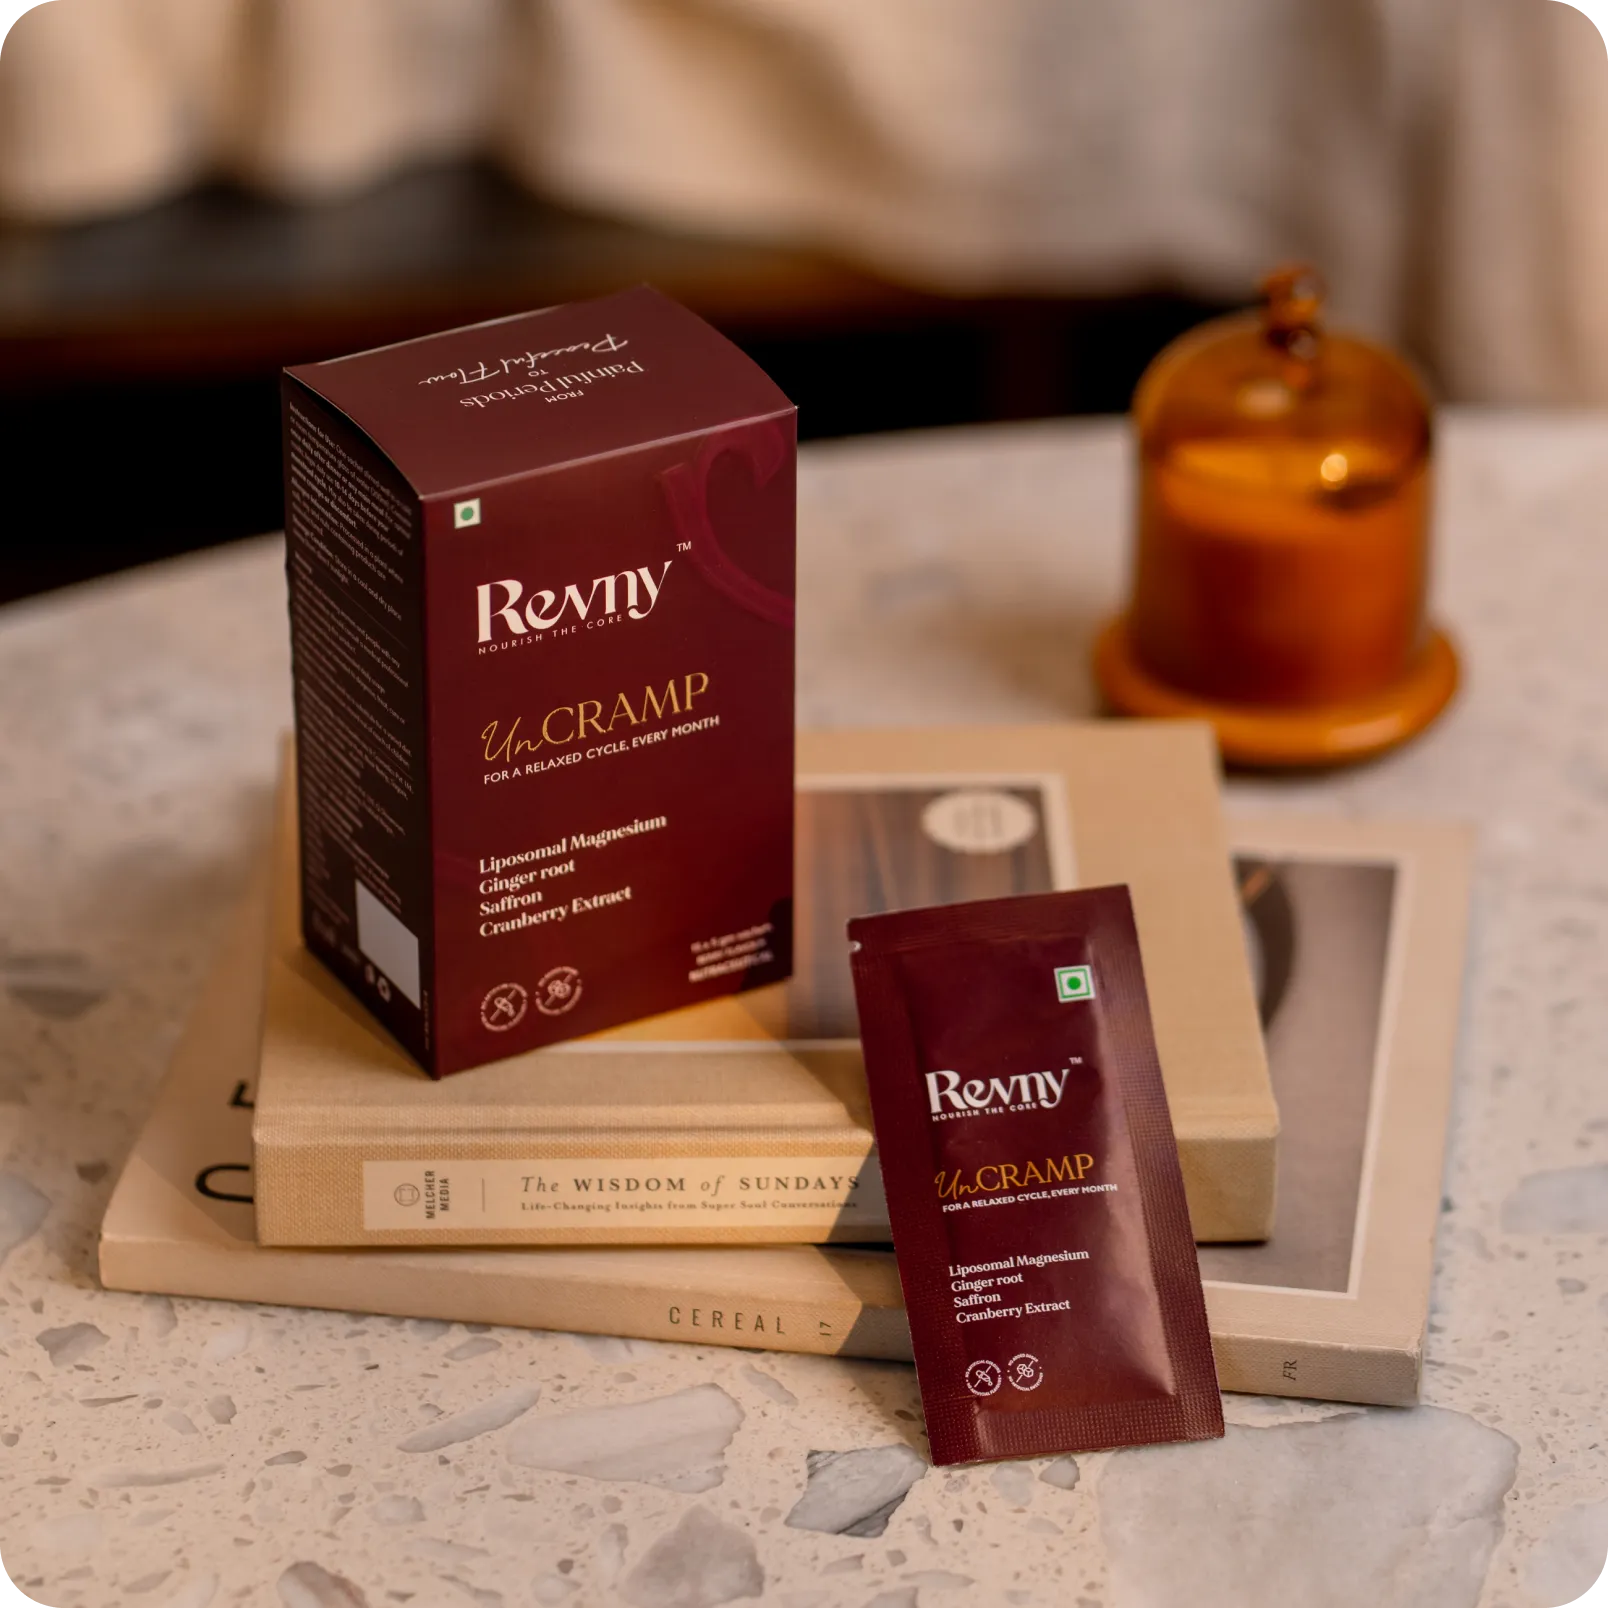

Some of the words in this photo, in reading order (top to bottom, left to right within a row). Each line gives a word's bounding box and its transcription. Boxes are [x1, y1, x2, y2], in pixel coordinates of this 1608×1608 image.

[500, 333, 629, 374] Peaceful
[418, 361, 501, 385] Flow
[528, 369, 549, 377] TO
[556, 361, 645, 389] Painful
[460, 380, 557, 408] Periods
[545, 389, 585, 403] FROM
[478, 633, 543, 655] NOURISH
[552, 625, 577, 638] THE
[587, 614, 623, 629] CORE
[481, 672, 709, 762] UnCRAMP
[484, 770, 509, 785] FOR
[512, 767, 522, 778] A
[525, 752, 583, 775] RELAXED
[586, 740, 630, 759] CYCLE,
[632, 728, 668, 748] EVERY
[672, 715, 720, 738] MONTH
[479, 838, 567, 874] Liposomal
[570, 815, 667, 849] Magnesium
[479, 870, 538, 895] Ginger
[541, 859, 575, 880] root
[479, 890, 543, 916] Saffron
[479, 904, 569, 937] Cranberry
[572, 885, 632, 914] Extract
[932, 1109, 981, 1122] NOURISH
[985, 1106, 1004, 1115] THE
[1009, 1102, 1038, 1112] CORE
[521, 1175, 559, 1193] The
[573, 1177, 686, 1192] WISDOM
[700, 1175, 725, 1197] of
[739, 1176, 861, 1191] SUNDAYS
[934, 1153, 1094, 1200] UnCRAMP
[424, 1170, 436, 1219] MELCHER
[439, 1177, 450, 1212] MEDIA
[521, 1201, 611, 1213] Life-Changing
[615, 1201, 663, 1211] Insights
[667, 1200, 697, 1210] from
[701, 1200, 736, 1212] Super
[740, 1199, 767, 1210] Soul
[772, 1199, 858, 1210] Conversations
[942, 1202, 962, 1213] FOR
[962, 1201, 971, 1210] A
[972, 1195, 1016, 1208] RELAXED
[1017, 1190, 1051, 1202] CYCLE,
[1051, 1187, 1080, 1198] EVERY
[1082, 1183, 1118, 1193] MONTH
[949, 1256, 1015, 1277] Liposomal
[1016, 1250, 1090, 1268] Magnesium
[951, 1277, 995, 1292] Ginger
[997, 1272, 1024, 1285] root
[953, 1293, 1001, 1308] Saffron
[956, 1306, 1023, 1324] Cranberry
[1025, 1300, 1071, 1314] Extract
[669, 1306, 786, 1334] CEREAL
[1283, 1359, 1297, 1381] FR
